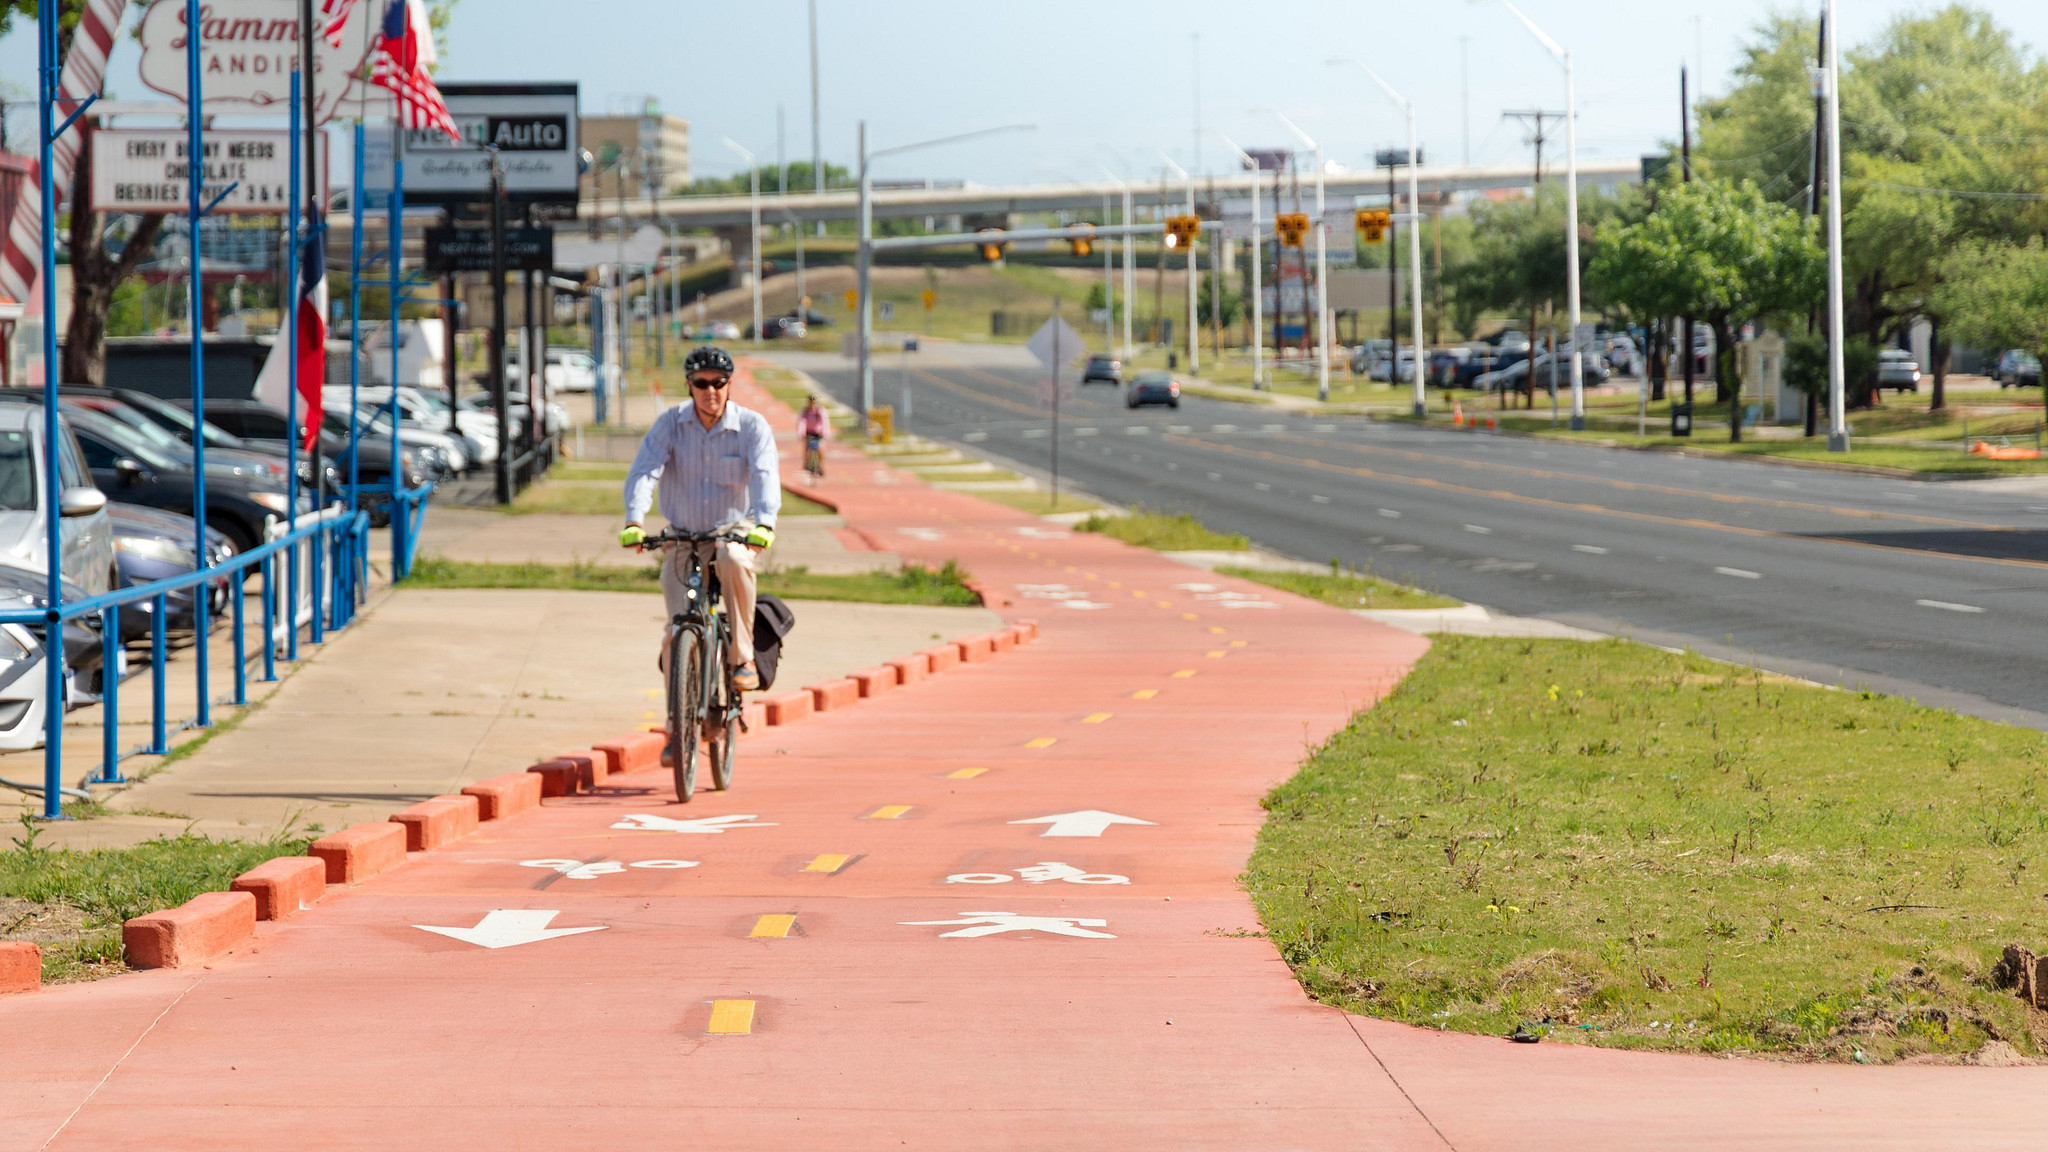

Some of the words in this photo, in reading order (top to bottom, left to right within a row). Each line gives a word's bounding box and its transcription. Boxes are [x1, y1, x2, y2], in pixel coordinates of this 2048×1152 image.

[170, 4, 326, 50] Lamme
[205, 55, 324, 74] ANDIES
[496, 120, 563, 147] Auto
[126, 140, 166, 158] EVERY
[176, 140, 220, 158] BUNY
[228, 141, 275, 159] NEEDS
[165, 162, 247, 180] CHOOLATE
[115, 183, 179, 200] BERRIES
[247, 184, 255, 200] 3
[275, 184, 283, 200] 4
